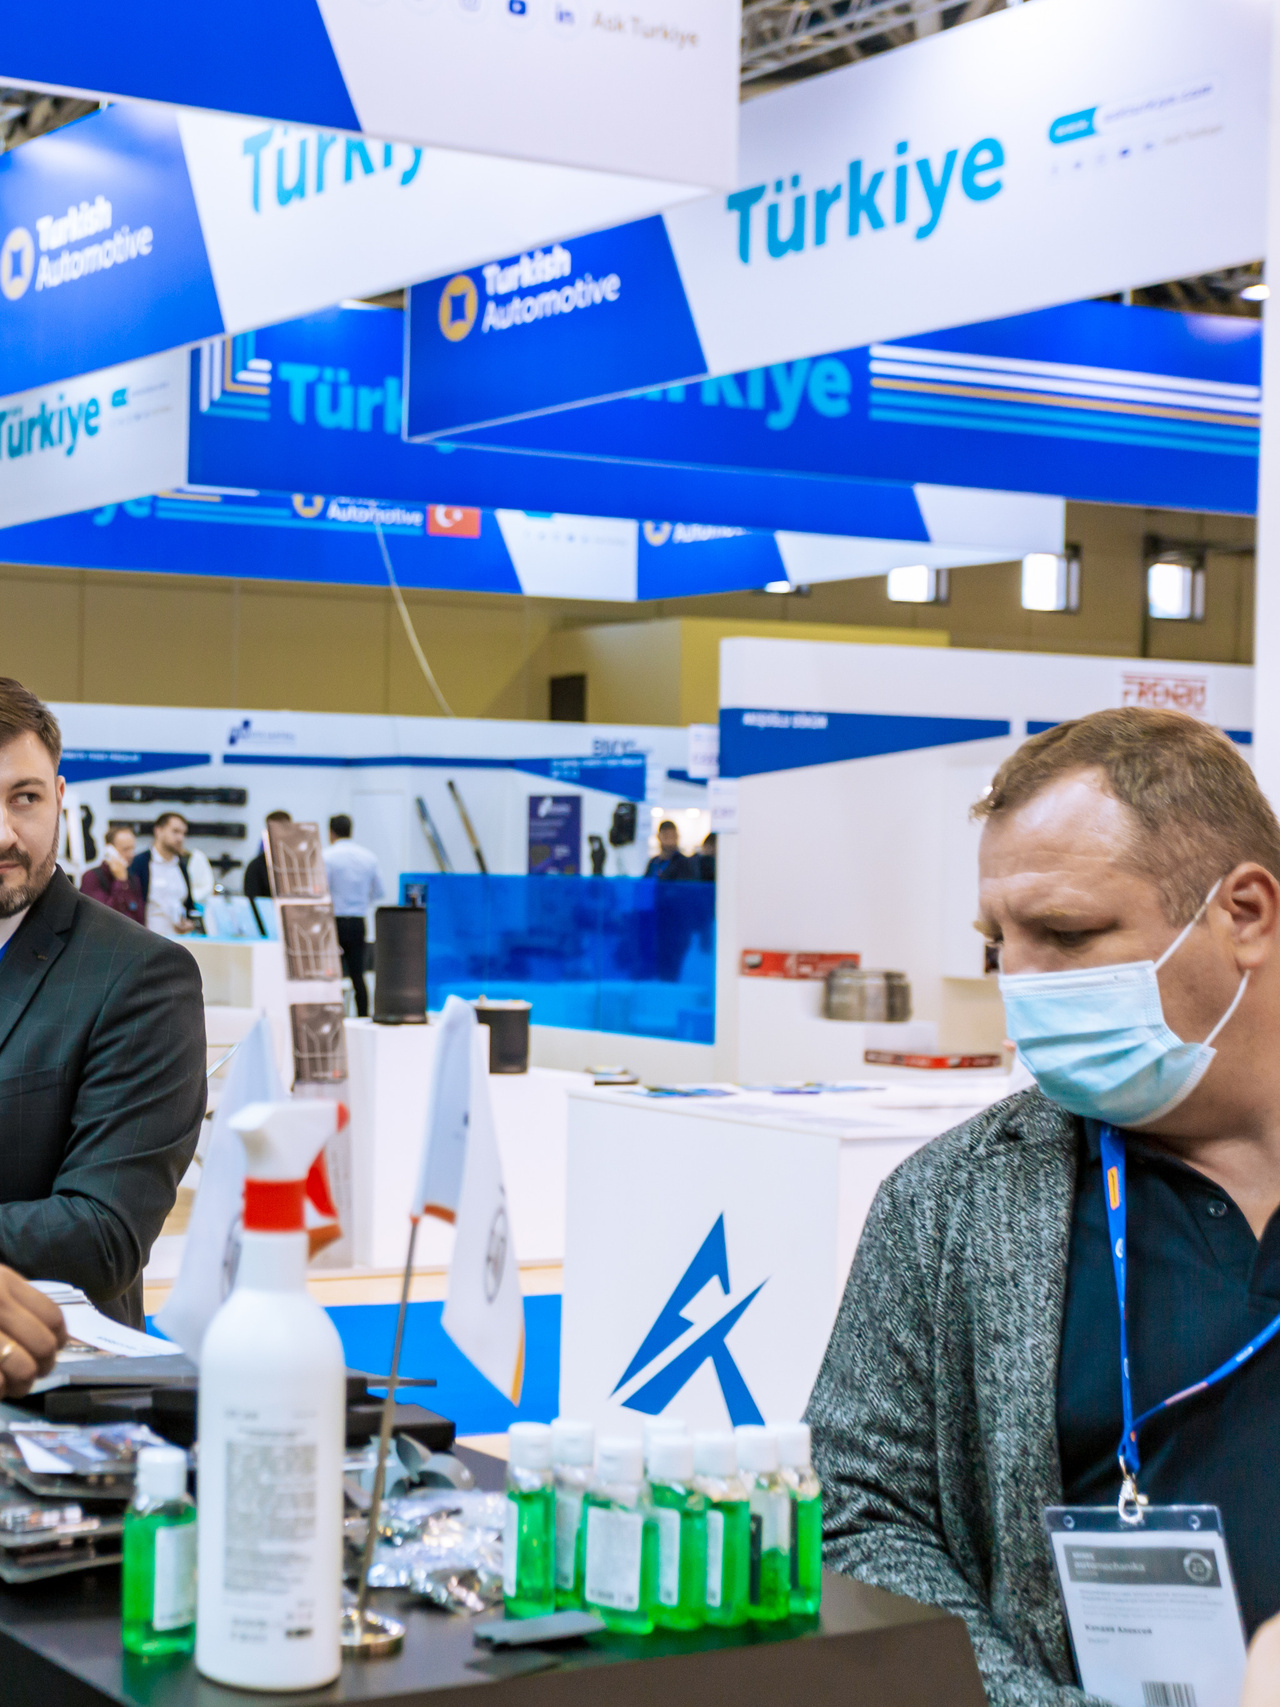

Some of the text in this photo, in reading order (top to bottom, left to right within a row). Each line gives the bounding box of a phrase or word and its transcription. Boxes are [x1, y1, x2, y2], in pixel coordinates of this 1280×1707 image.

[36, 194, 113, 252] Turkish
[727, 137, 1005, 264] Türkiye
[35, 224, 154, 293] Automotive
[482, 243, 572, 296] Turkish
[481, 272, 621, 334] Automotive
[326, 500, 425, 527] Automotive
